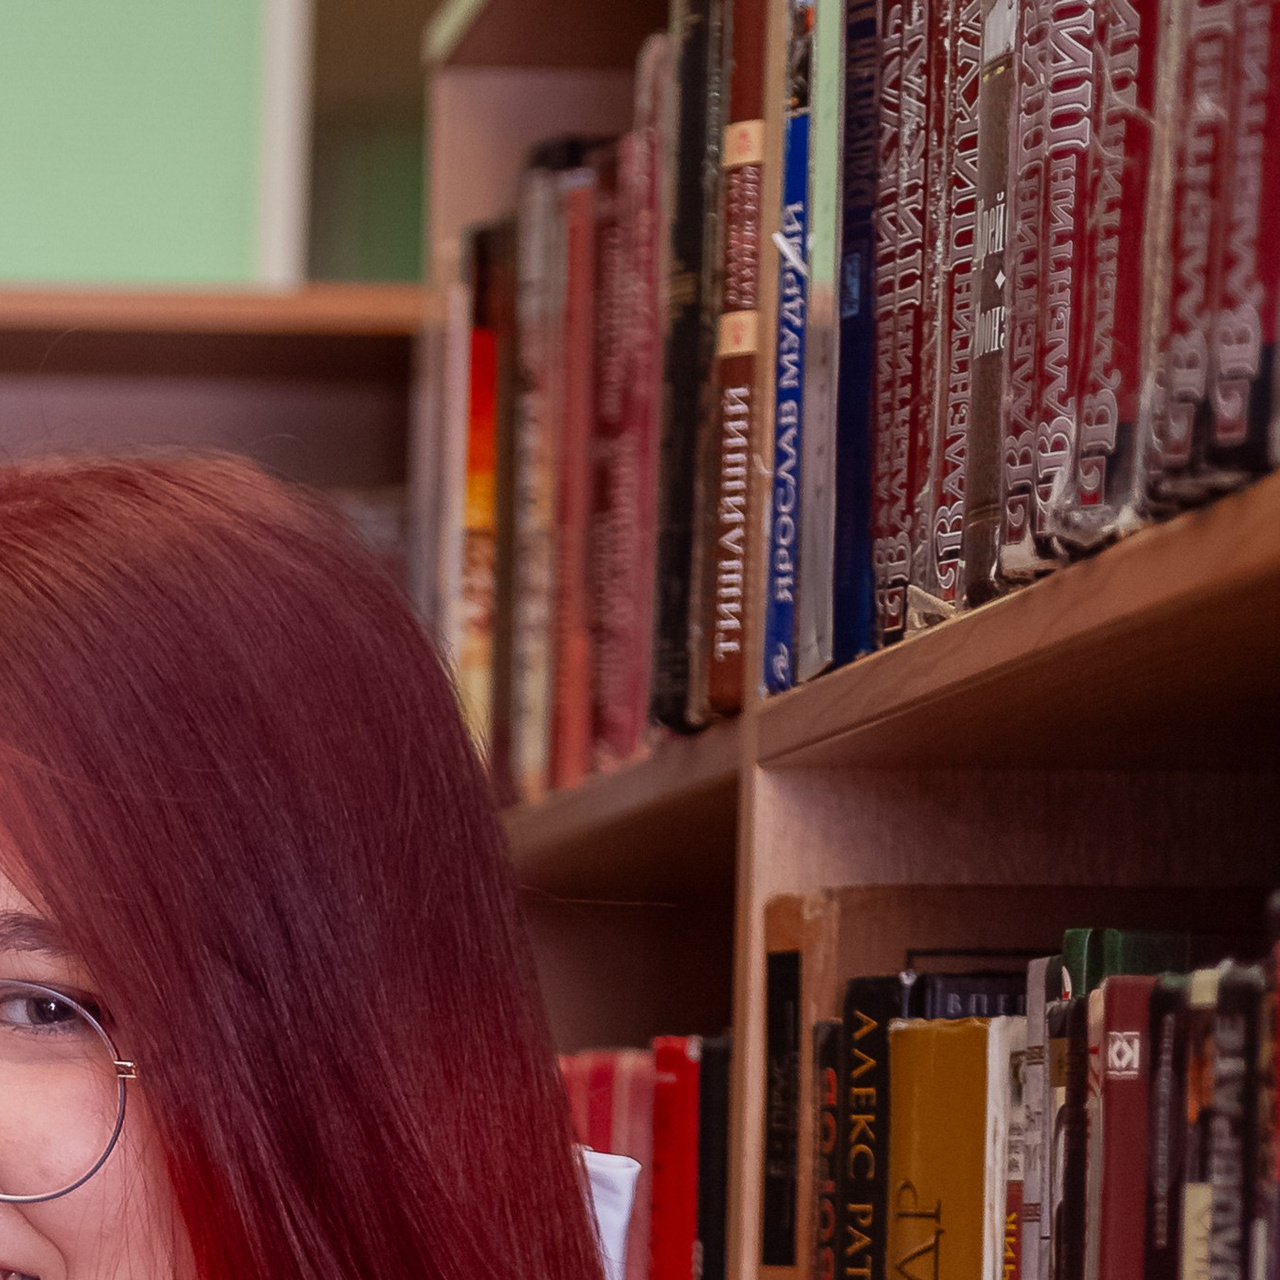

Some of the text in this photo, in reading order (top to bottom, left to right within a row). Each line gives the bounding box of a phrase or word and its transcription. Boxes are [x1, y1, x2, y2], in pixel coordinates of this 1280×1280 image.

[883, 310, 914, 630] ВАЛЕНТИН
[933, 270, 978, 590] ВАЛЕНТИН
[1005, 177, 1042, 548] ВАЛЕНТИН
[1035, 152, 1077, 532] ВАЛЕНТИН
[1078, 117, 1123, 506] ВАЛЕНТИН
[773, 400, 799, 602] ЯРОСЛАВ
